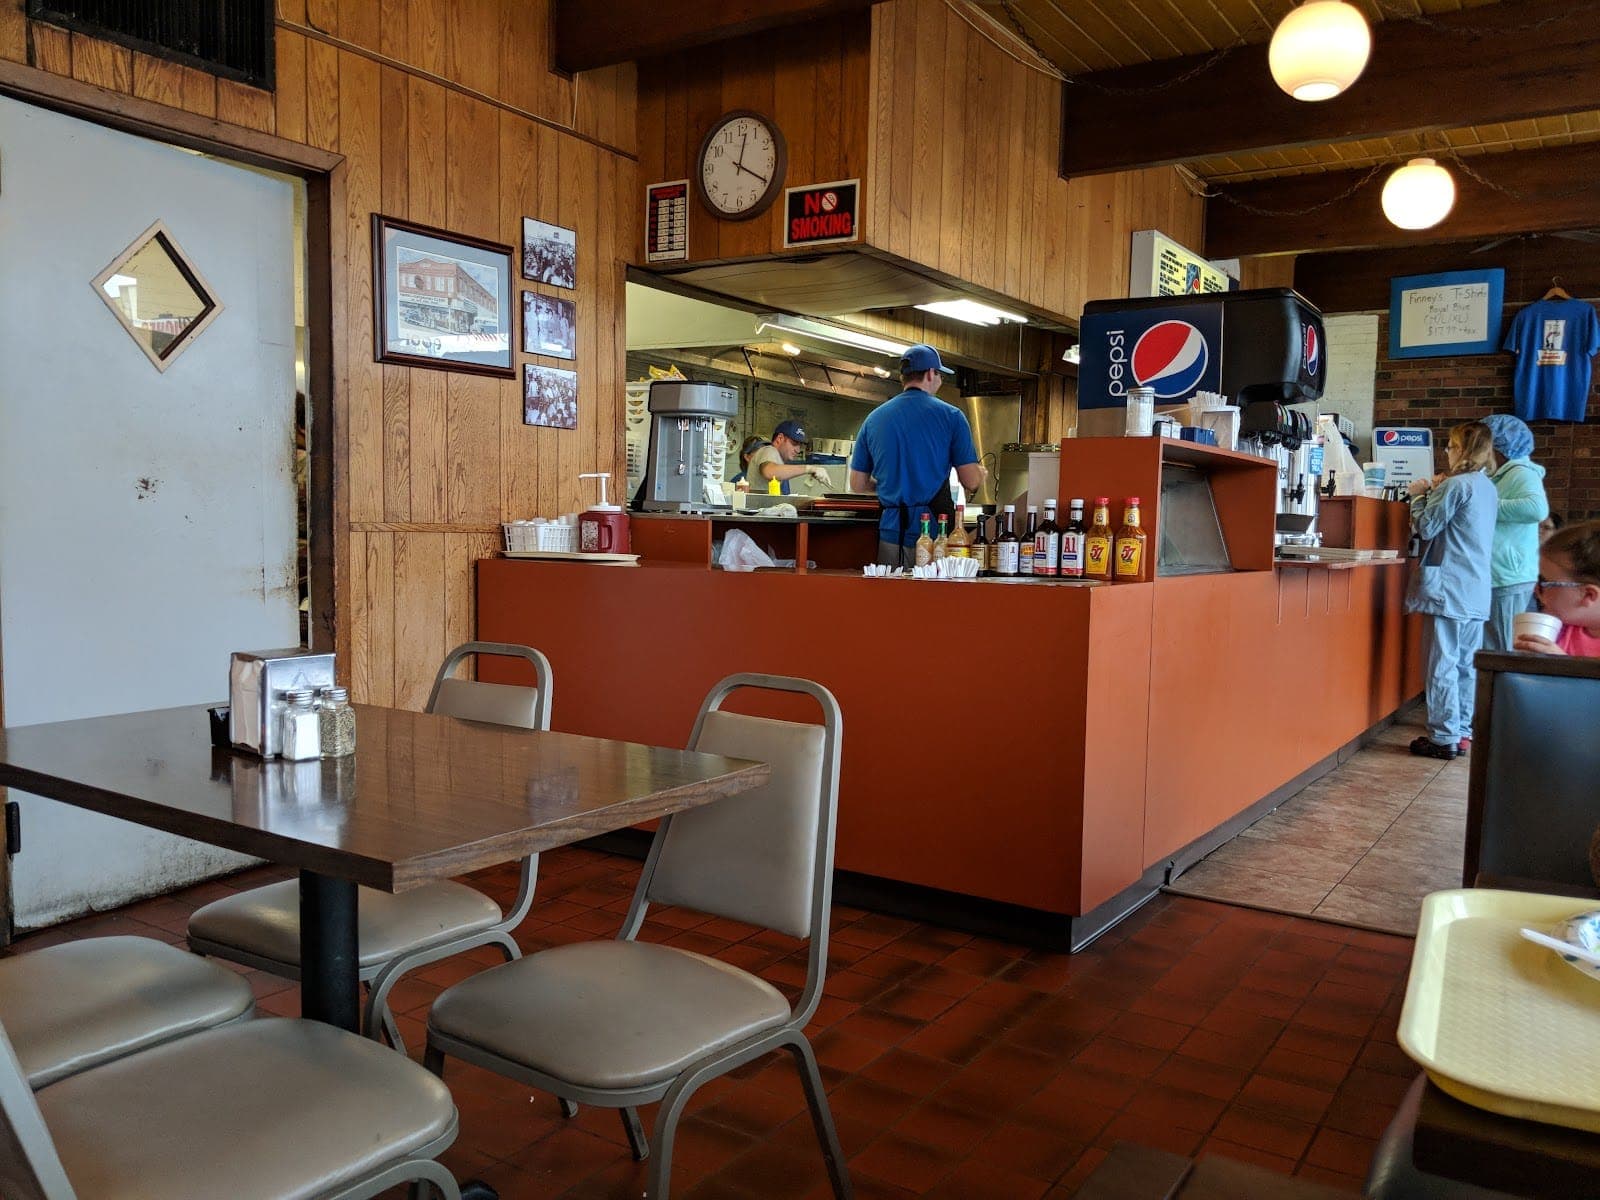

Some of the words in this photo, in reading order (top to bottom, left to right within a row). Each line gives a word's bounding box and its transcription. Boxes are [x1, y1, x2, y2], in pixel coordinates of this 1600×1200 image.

[737, 124, 748, 137] 12
[725, 132, 733, 144] 11
[762, 138, 769, 151] 2
[714, 145, 724, 158] 10
[708, 163, 714, 174] 9
[767, 157, 774, 169] 3
[711, 181, 718, 193] 8
[722, 193, 729, 205] 7
[737, 195, 743, 207] 6
[750, 189, 757, 201] 5
[804, 191, 837, 215] NO
[791, 212, 851, 240] SMOKING
[1106, 330, 1128, 396] pepsi
[1400, 434, 1423, 443] pepsi
[1090, 544, 1105, 560] 57
[1121, 545, 1137, 560] 57
